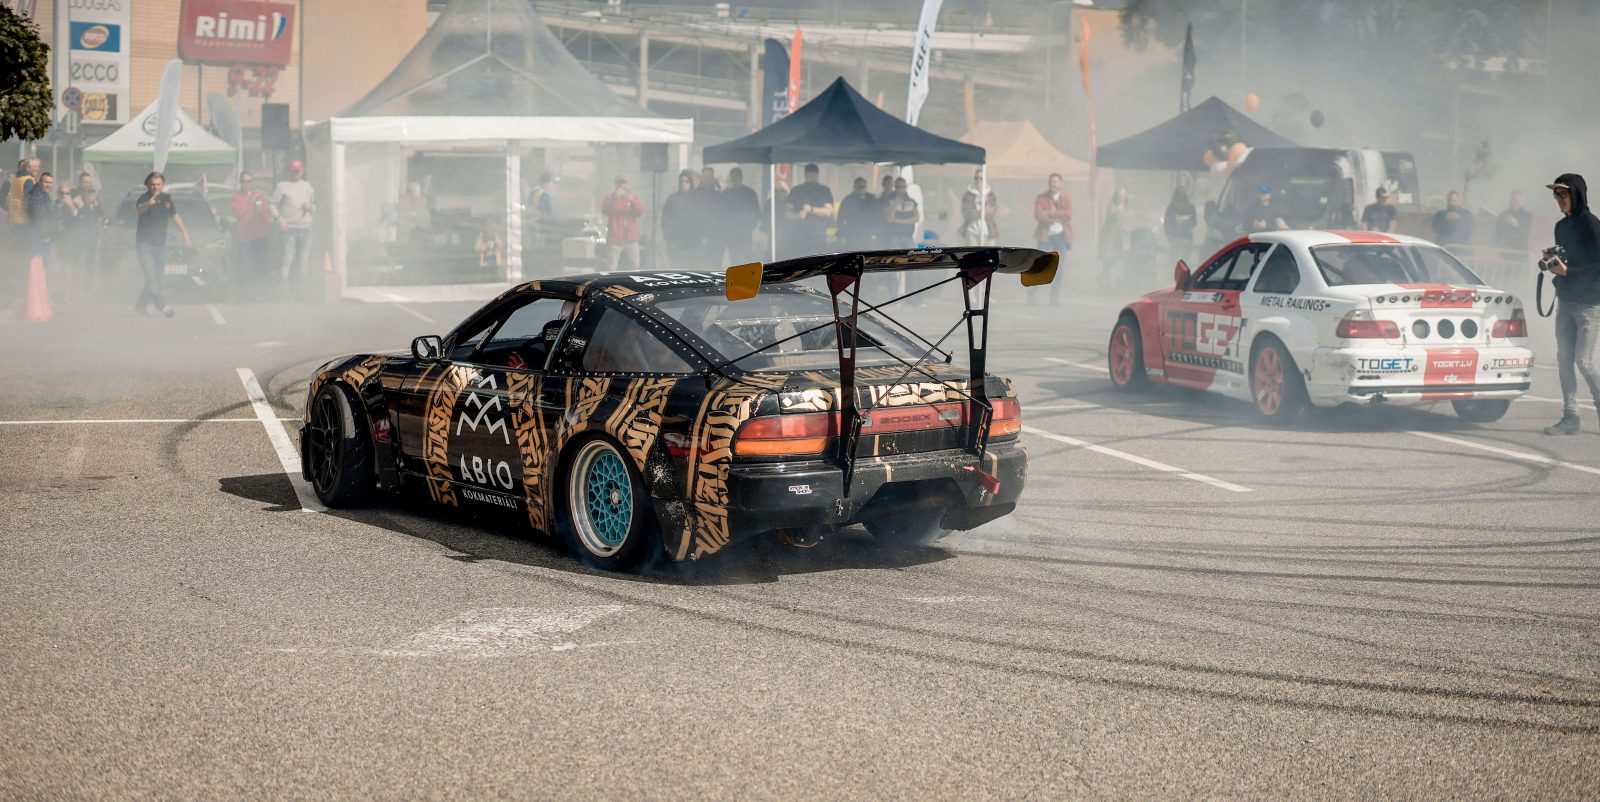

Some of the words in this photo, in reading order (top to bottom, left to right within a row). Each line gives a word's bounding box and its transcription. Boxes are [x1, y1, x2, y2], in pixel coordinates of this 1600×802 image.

[195, 11, 267, 41] Rimi
[227, 64, 279, 97] 9-22
[1261, 296, 1284, 308] METAL
[1286, 298, 1326, 312] RAILINGS
[1357, 358, 1414, 370] TOGET
[1432, 360, 1473, 368] TOGET.LV
[460, 453, 514, 490] ABIO
